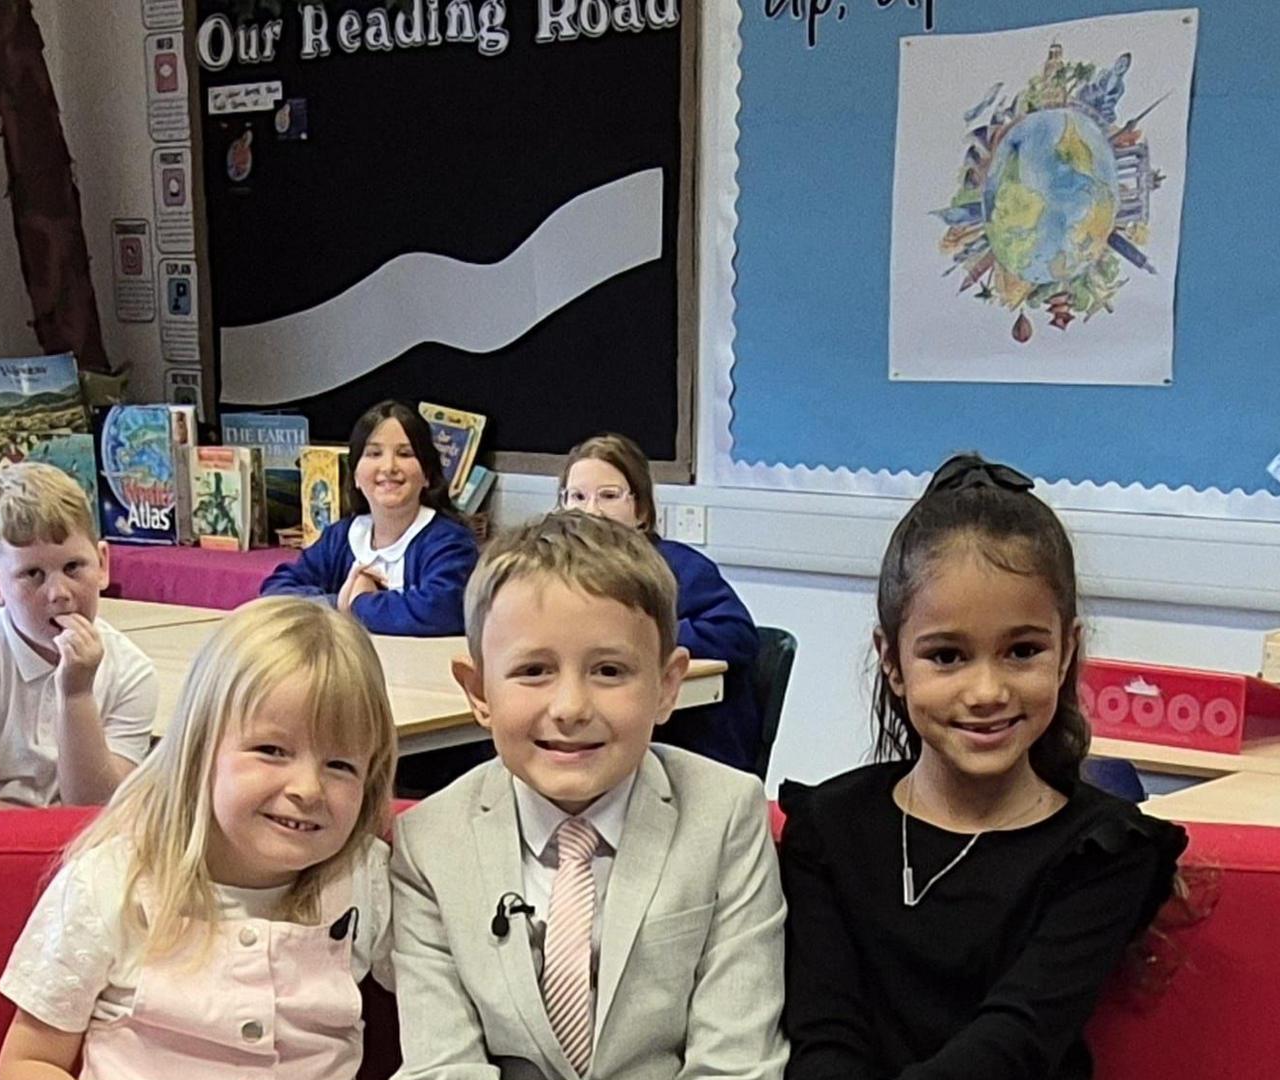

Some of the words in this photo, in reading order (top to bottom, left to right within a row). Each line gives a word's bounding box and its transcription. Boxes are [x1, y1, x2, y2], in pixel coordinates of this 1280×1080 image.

[197, 14, 281, 71] Our
[301, 0, 508, 56] Reading
[534, 0, 679, 43] Road
[257, 428, 306, 445] EARTH
[128, 500, 171, 531] Atlas
